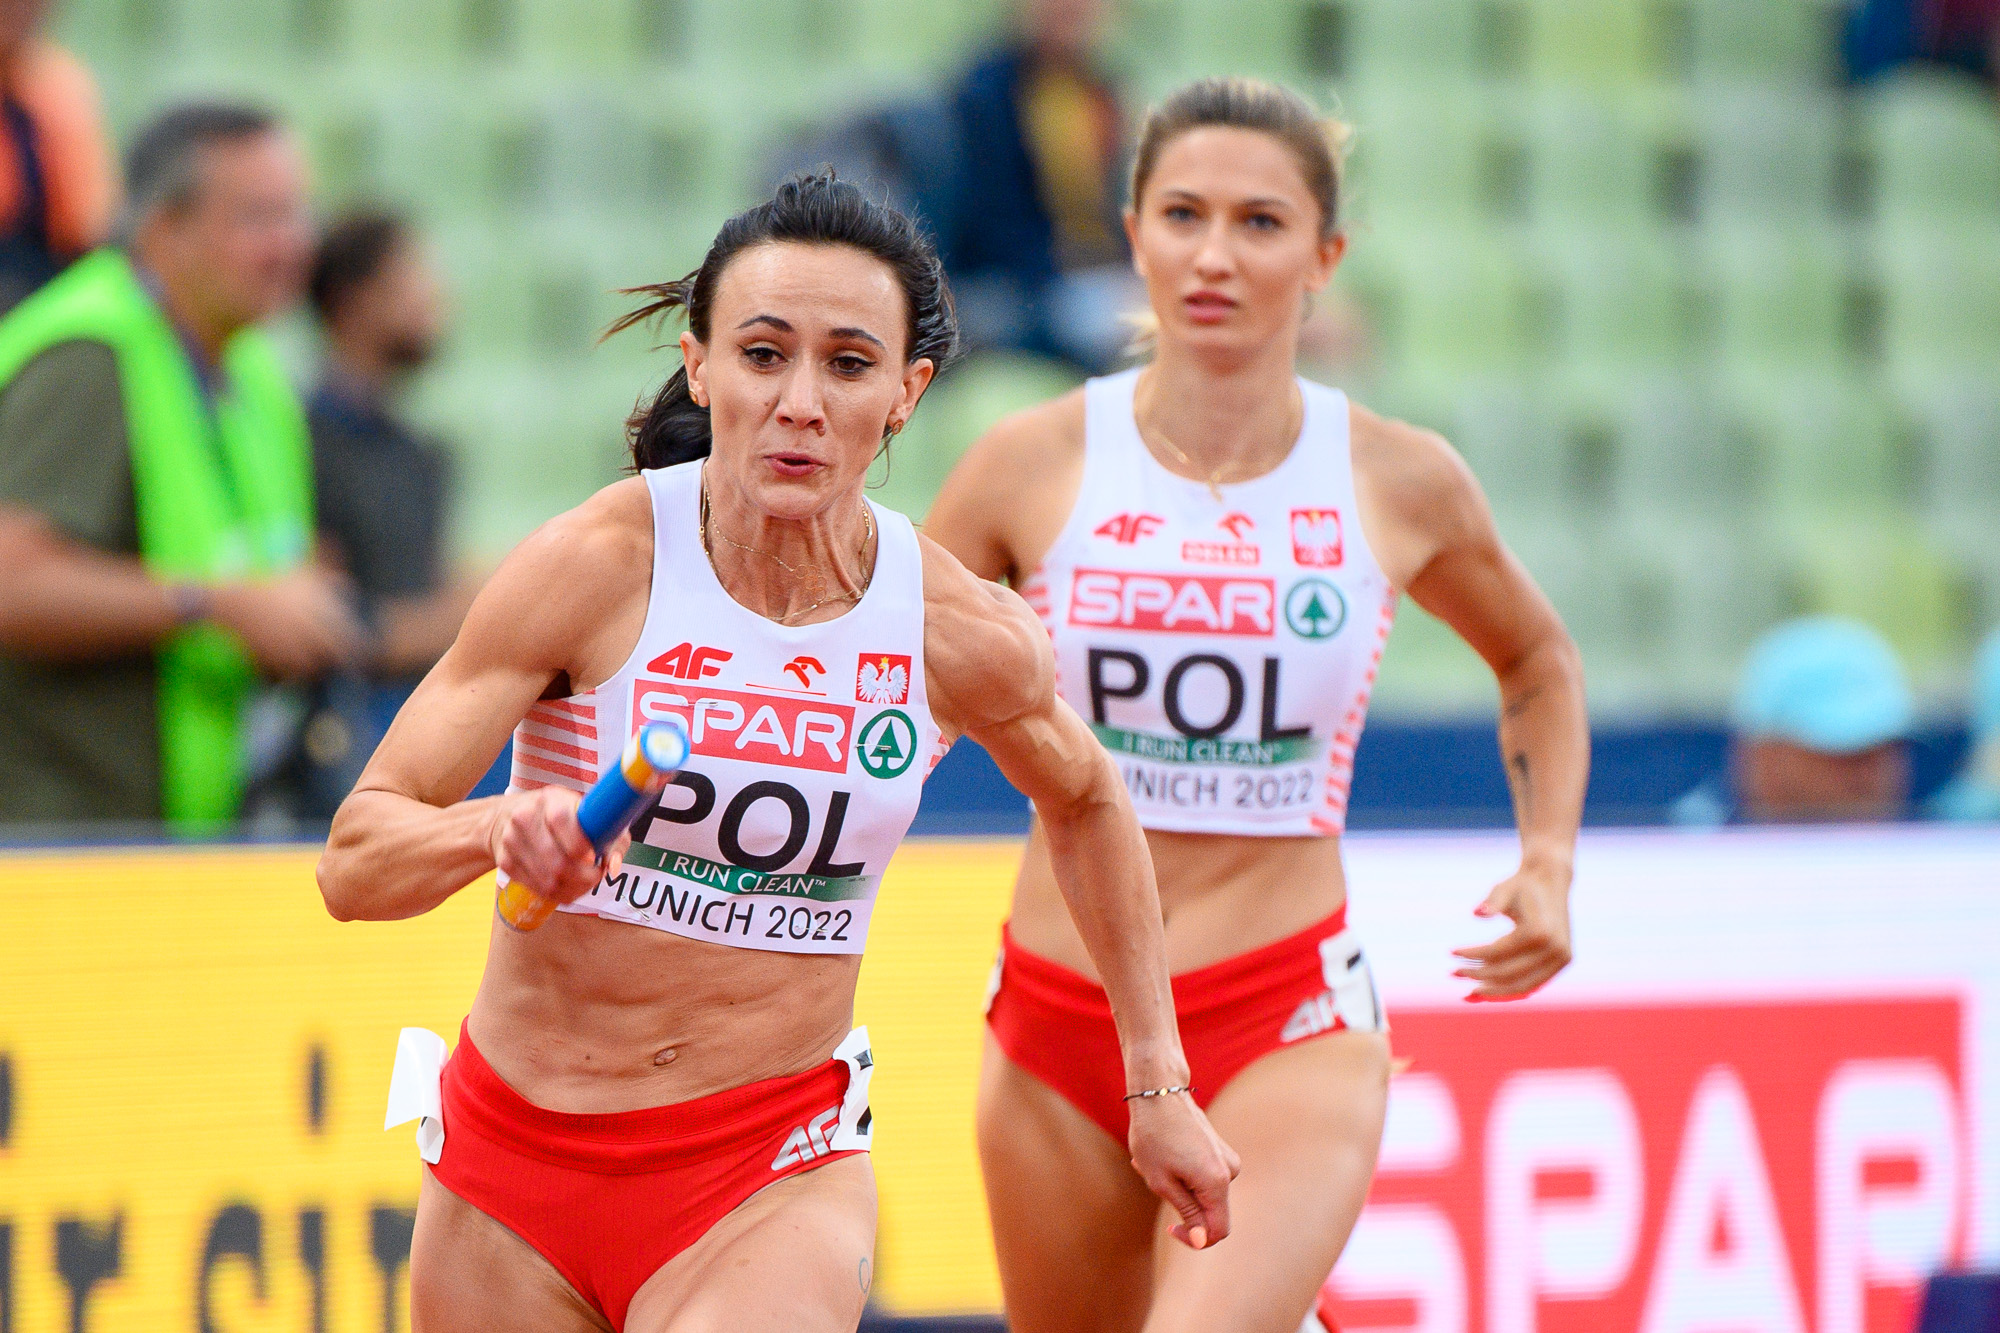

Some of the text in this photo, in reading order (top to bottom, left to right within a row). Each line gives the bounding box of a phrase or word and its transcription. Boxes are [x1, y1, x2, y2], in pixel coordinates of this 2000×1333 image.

[1094, 513, 1165, 544] 4F
[1074, 573, 1272, 631] SPAR
[647, 642, 733, 680] 4F
[1088, 648, 1311, 741] POL
[639, 691, 845, 762] SPAR
[1136, 736, 1187, 761] RUN
[1232, 769, 1314, 809] 2022
[627, 769, 867, 878] POL
[658, 852, 668, 868] I
[673, 855, 731, 888] RUN
[592, 872, 852, 942] MUNICH 2022
